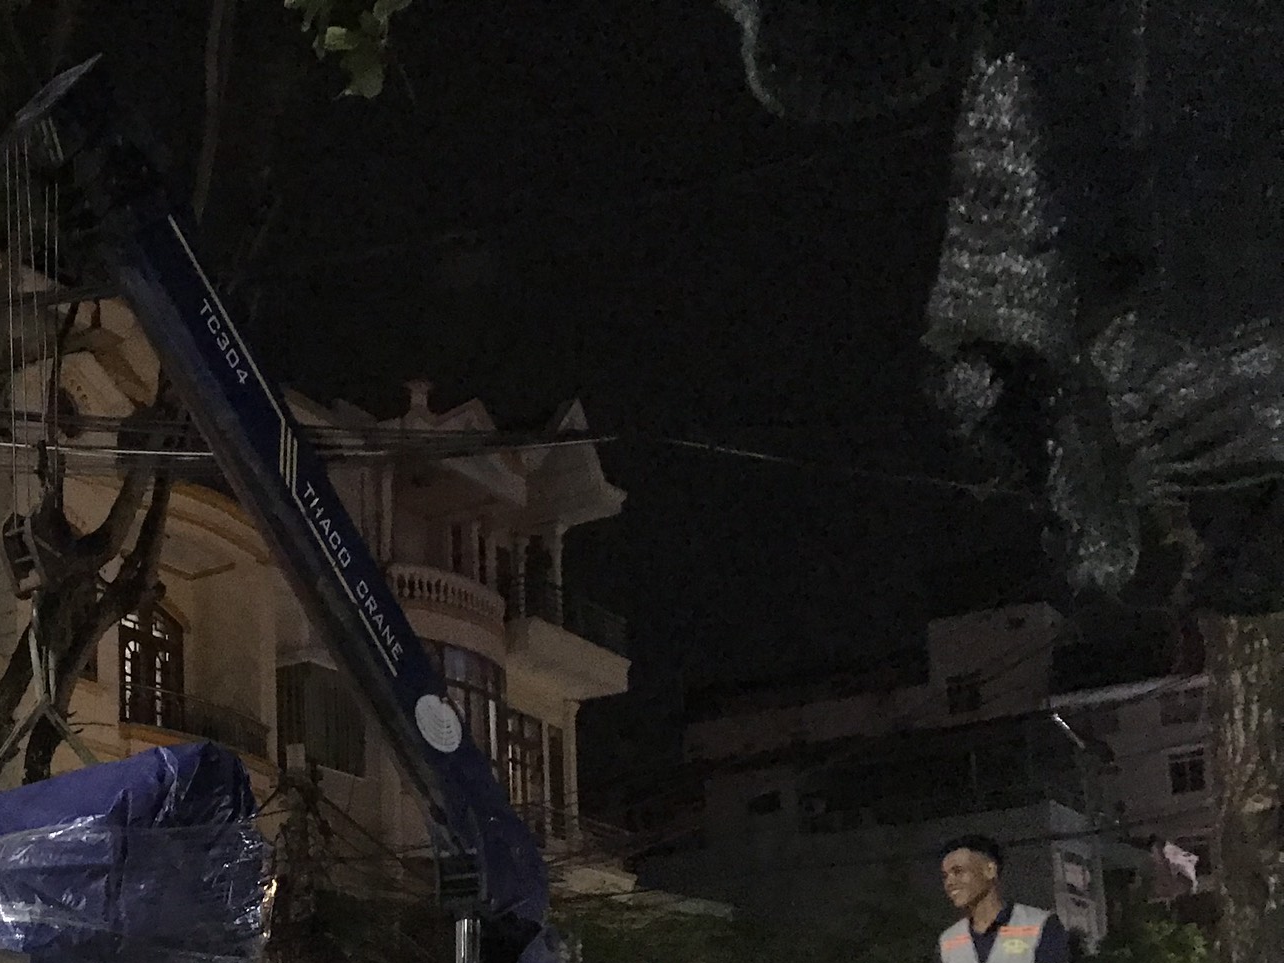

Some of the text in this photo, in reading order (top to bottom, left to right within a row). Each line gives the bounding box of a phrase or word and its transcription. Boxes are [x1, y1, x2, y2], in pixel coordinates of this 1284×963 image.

[200, 298, 248, 385] TC304
[304, 481, 404, 661] THACO CRANE
